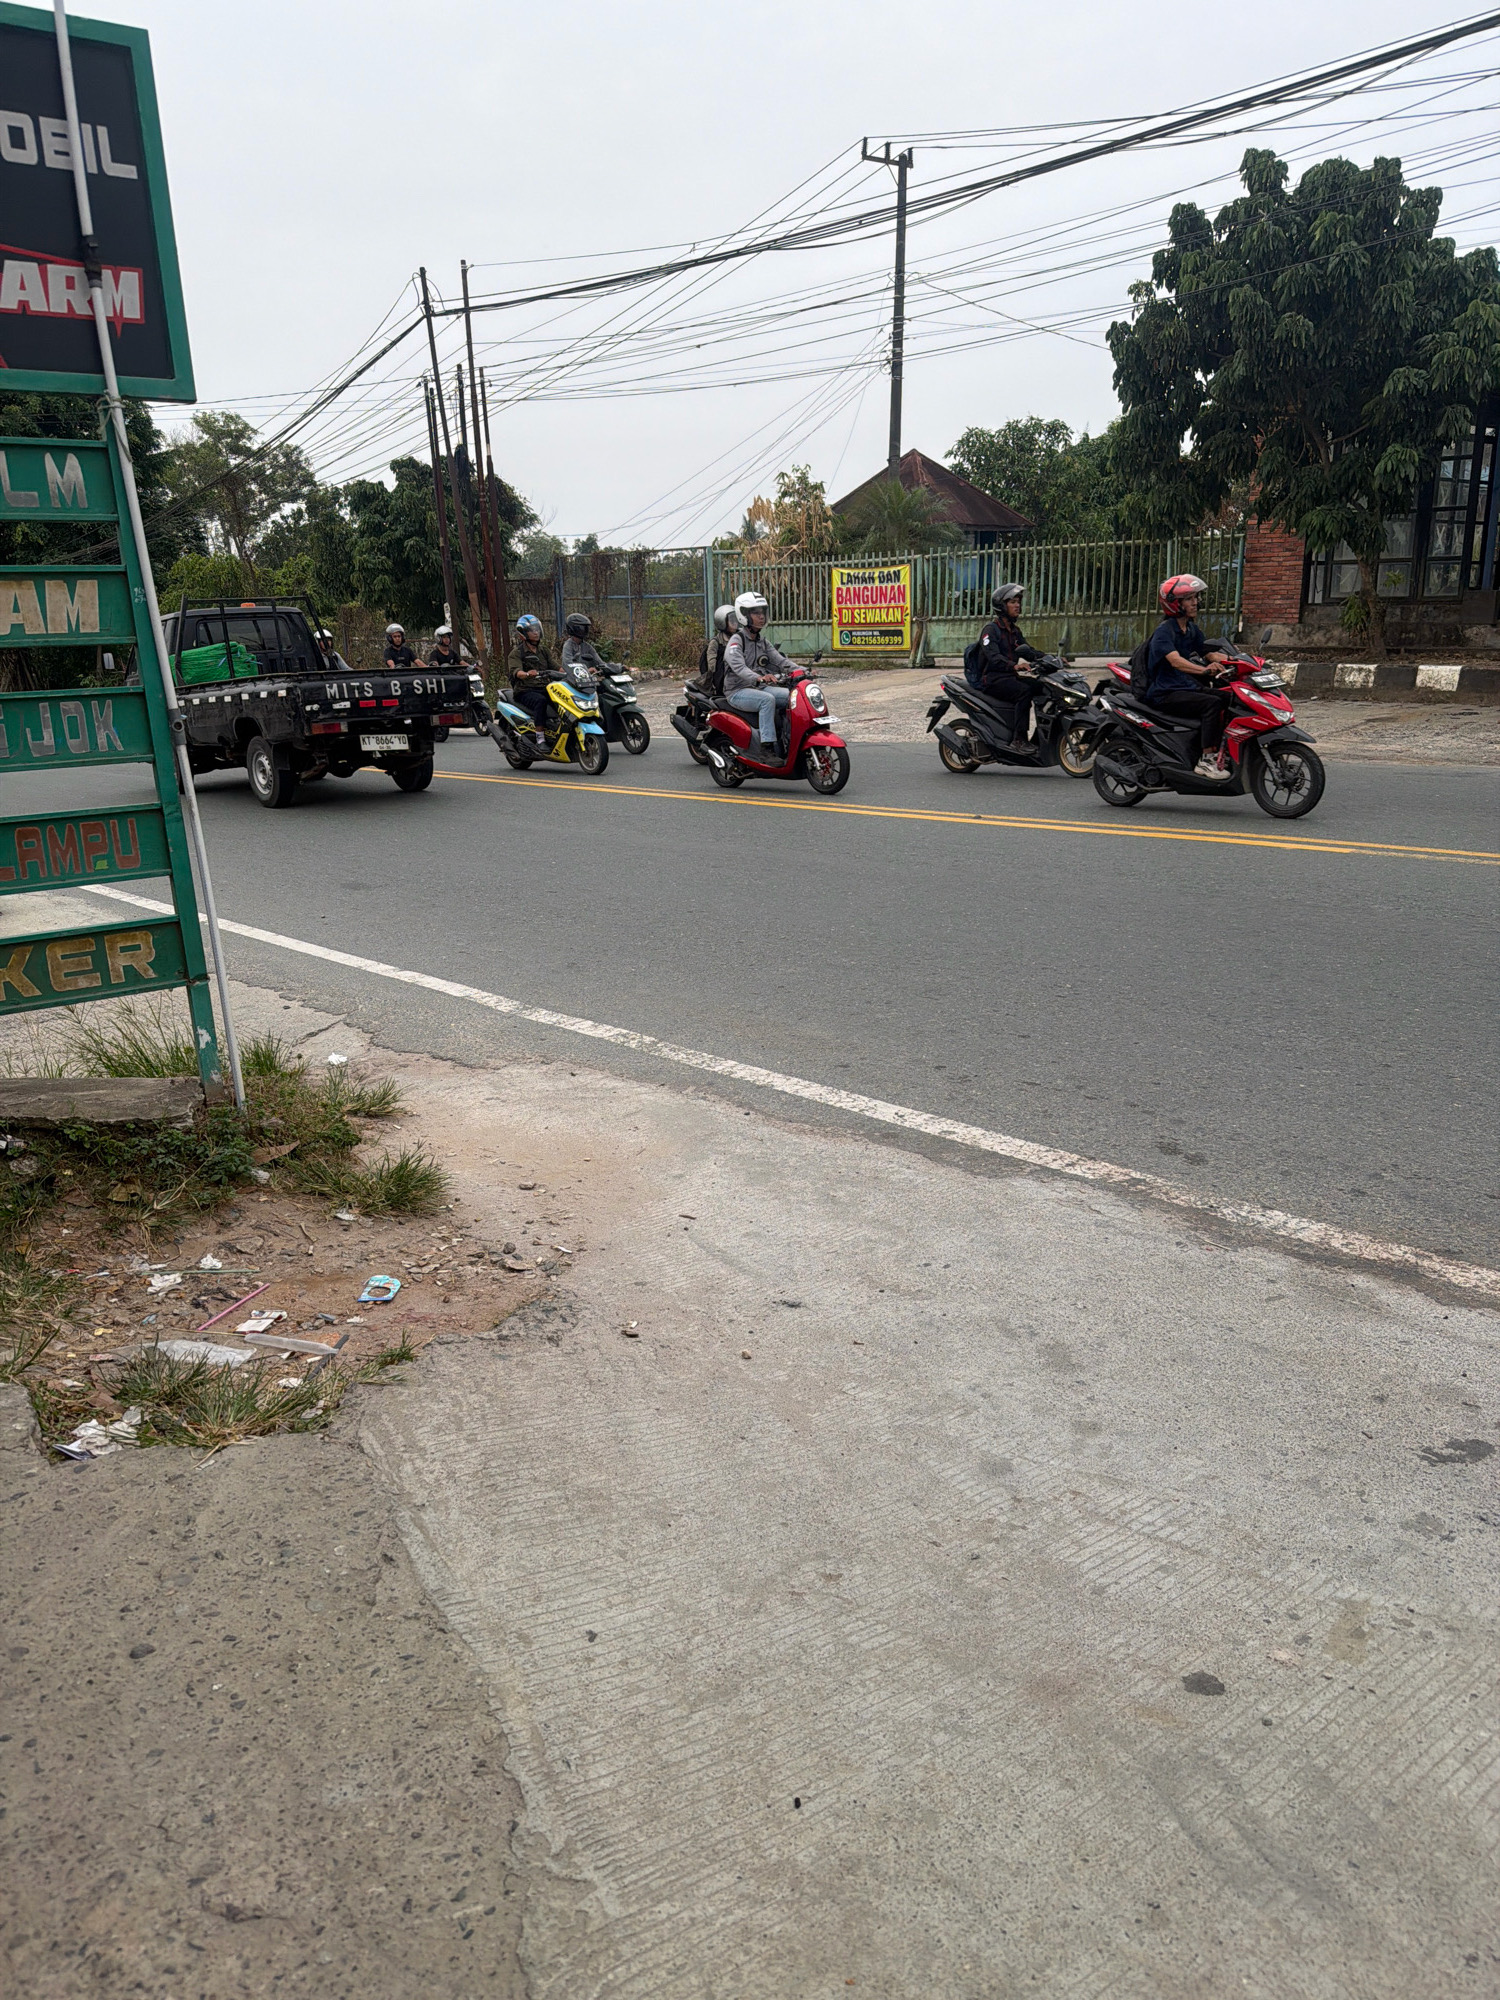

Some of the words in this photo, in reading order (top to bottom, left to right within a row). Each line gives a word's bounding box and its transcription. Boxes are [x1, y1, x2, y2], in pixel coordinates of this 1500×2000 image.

[840, 571, 876, 586] LAHAN
[877, 570, 901, 584] DAN
[836, 584, 906, 605] BANGUNAN
[842, 608, 852, 624] DI
[853, 607, 902, 624] SEWAKAN
[325, 681, 374, 700] MITS
[390, 680, 402, 696] B
[412, 677, 447, 695] SHI
[26, 699, 125, 758] JOK
[361, 736, 371, 746] KT
[0, 930, 158, 1001] KER
